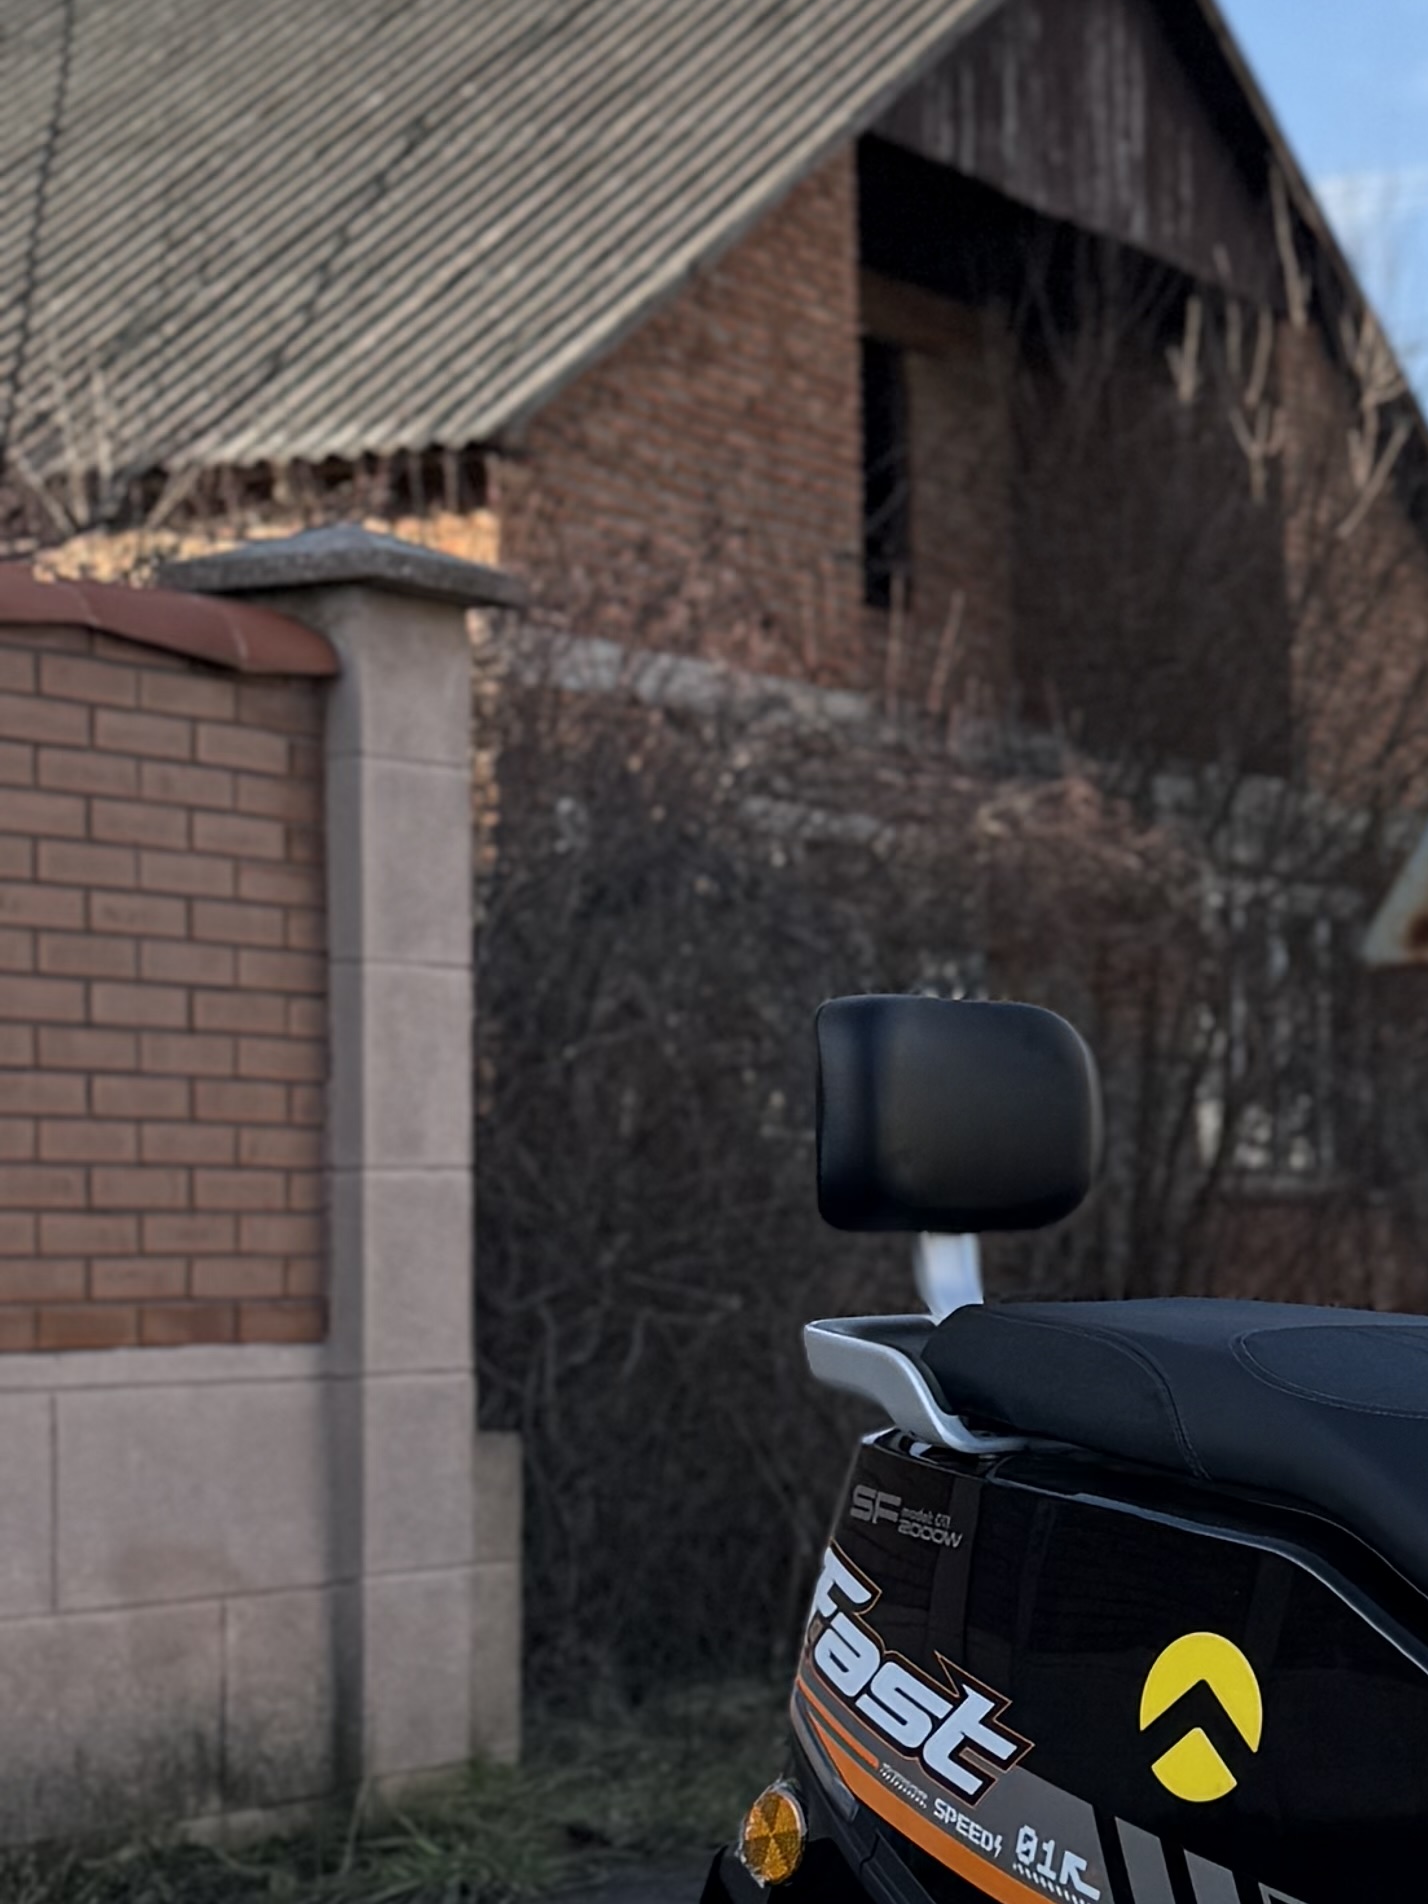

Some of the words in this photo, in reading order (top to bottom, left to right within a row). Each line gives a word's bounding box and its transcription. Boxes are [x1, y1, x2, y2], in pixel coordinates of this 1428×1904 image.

[849, 1484, 902, 1525] SF
[898, 1518, 963, 1548] 2000W
[812, 1546, 1018, 1797] Fast
[933, 1797, 995, 1852] SPEED
